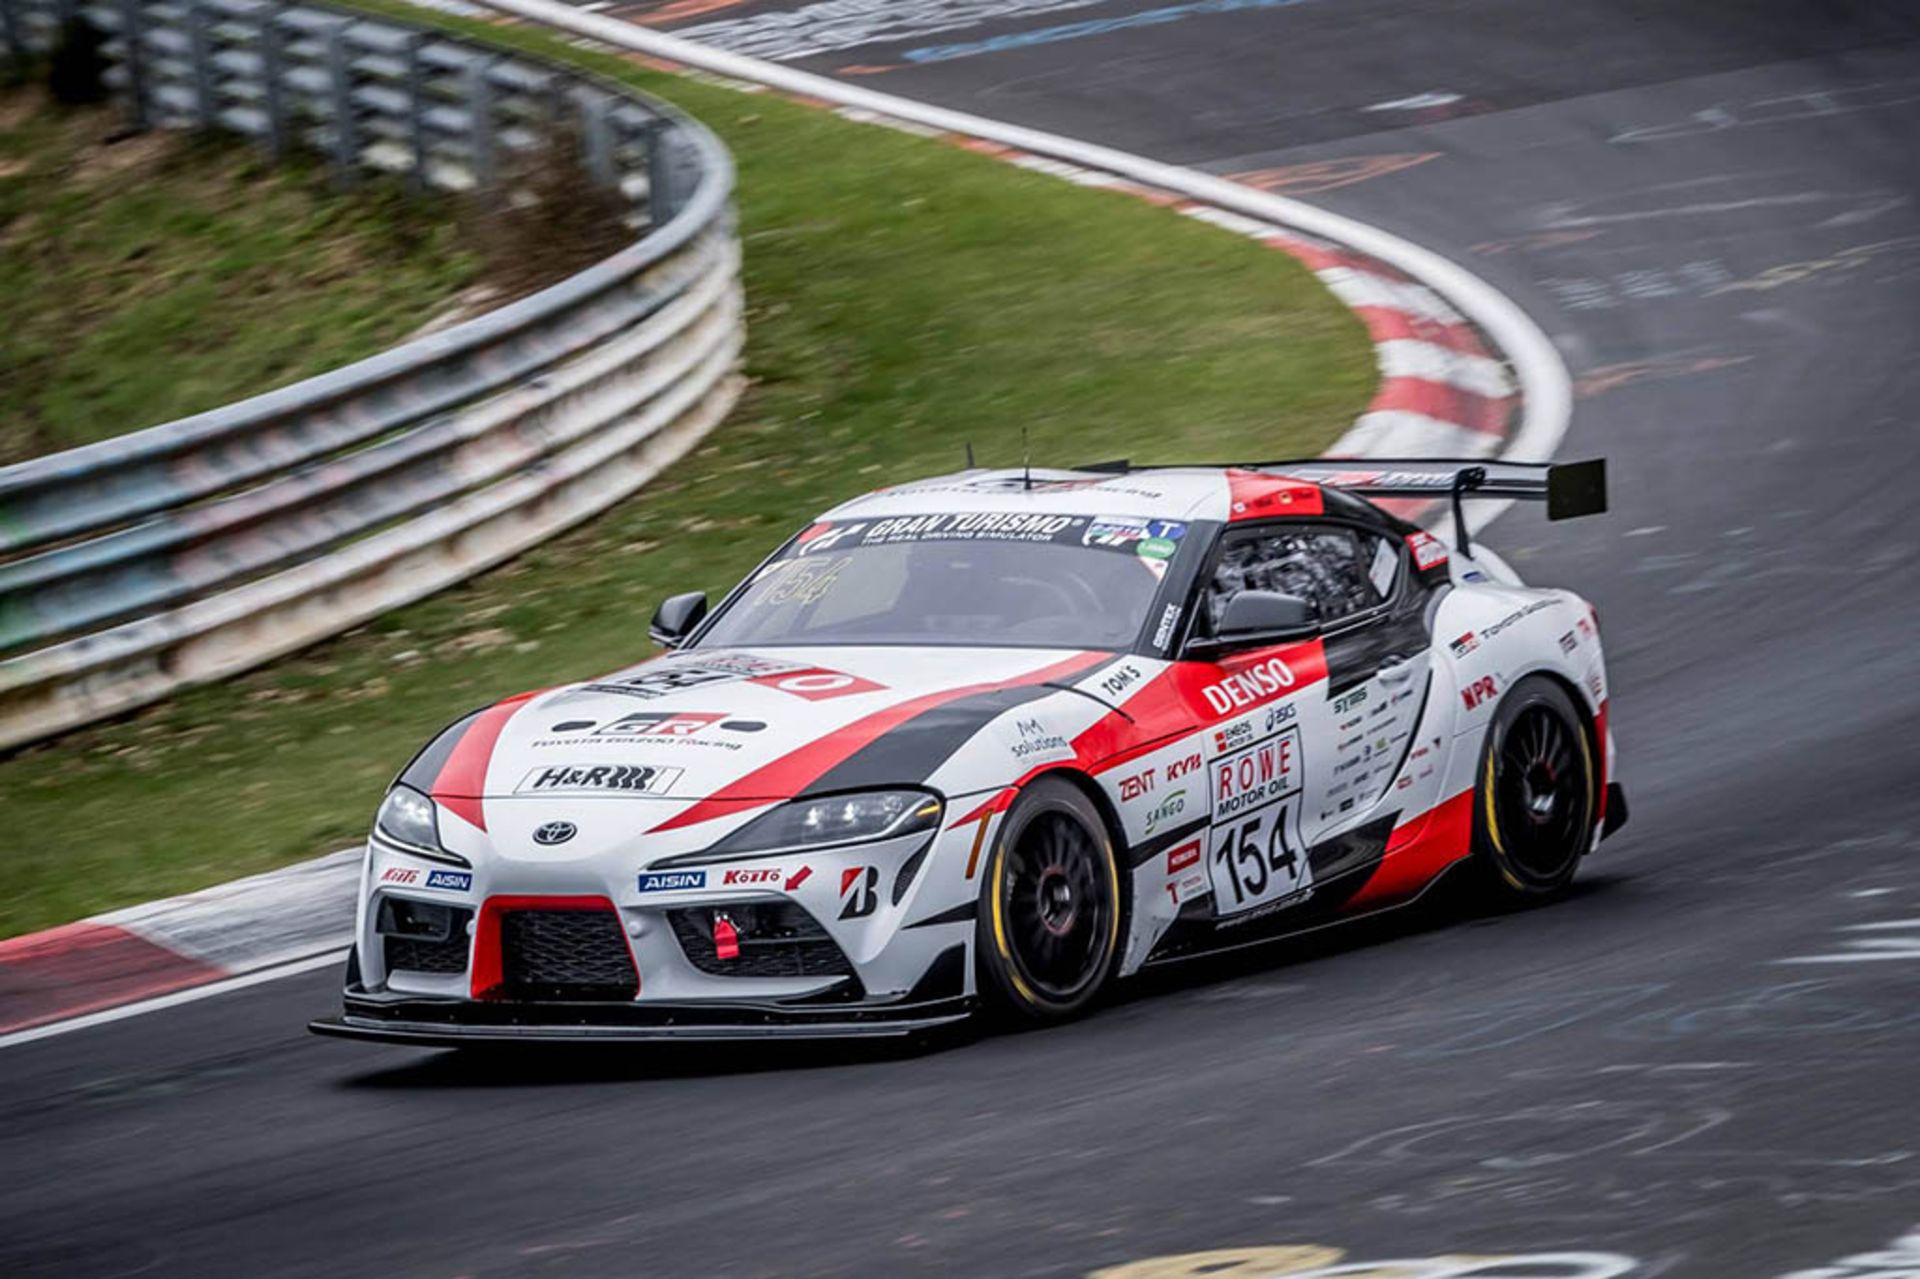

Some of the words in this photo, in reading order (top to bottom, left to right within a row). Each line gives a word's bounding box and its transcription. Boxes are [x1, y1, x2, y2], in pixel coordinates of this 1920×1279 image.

[866, 514, 947, 538] GRAN
[945, 512, 1072, 535] TURISMO
[921, 531, 974, 541] DRIVING
[975, 531, 1053, 542] SIMULATOR
[1201, 658, 1296, 716] DENSO
[1460, 675, 1499, 712] NPR
[601, 719, 710, 736] GR
[1011, 735, 1068, 758] solutions
[533, 766, 612, 790] H&R
[1217, 740, 1292, 801] ROWE
[1118, 768, 1156, 802] ZENT
[1217, 787, 1266, 817] MOTOR
[1268, 775, 1290, 796] OIL
[1216, 804, 1298, 905] 154
[430, 872, 470, 889] AISIN
[643, 873, 702, 890] AISIN
